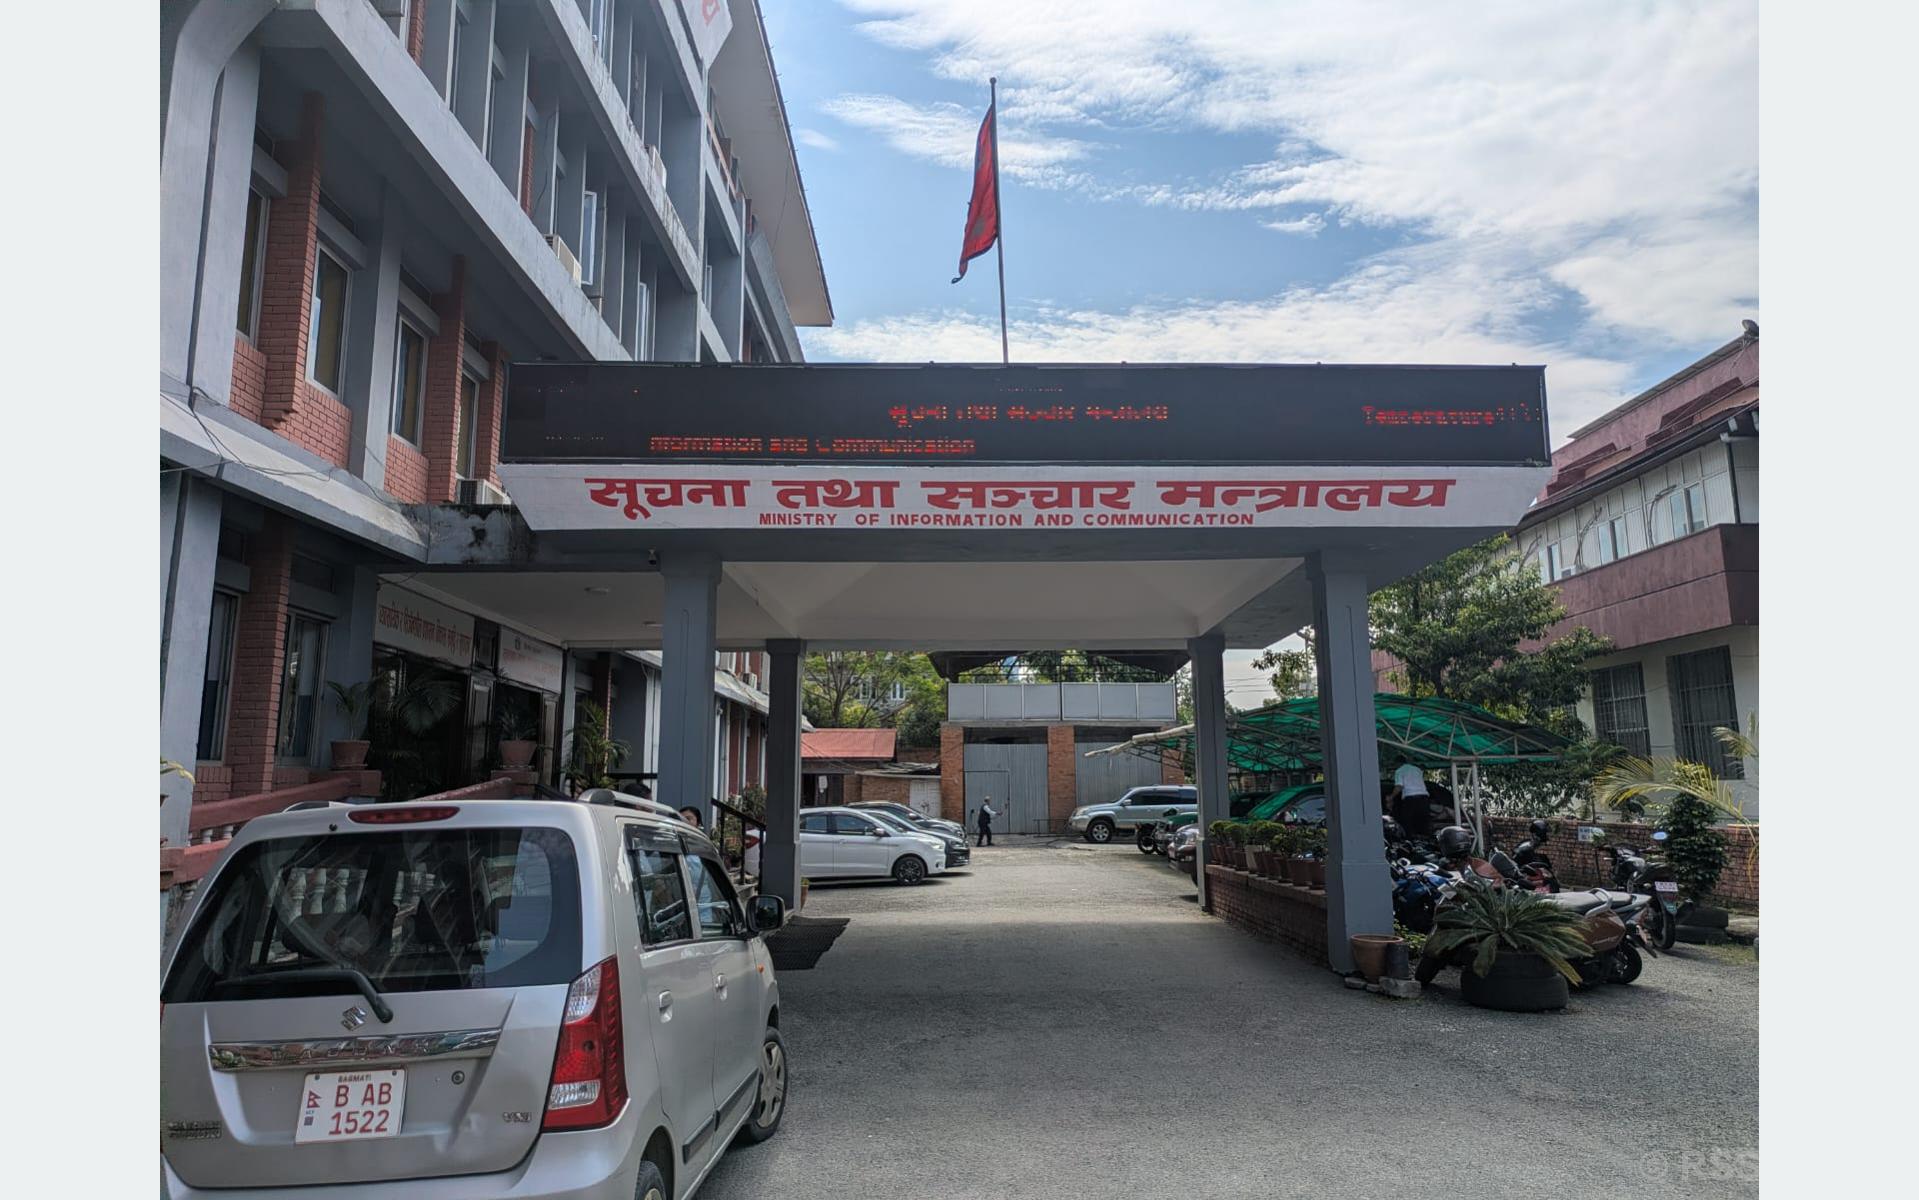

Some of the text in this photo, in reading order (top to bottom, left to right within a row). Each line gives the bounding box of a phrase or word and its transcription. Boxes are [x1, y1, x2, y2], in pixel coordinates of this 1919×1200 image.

[584, 478, 1456, 520] सूचना तथा सञ्चार मन्त्रालय
[759, 512, 1254, 527] MINISTRY OF INFORMATION AND COMMUNICATION
[335, 1082, 392, 1107] B AB
[328, 1109, 390, 1136] 1522
